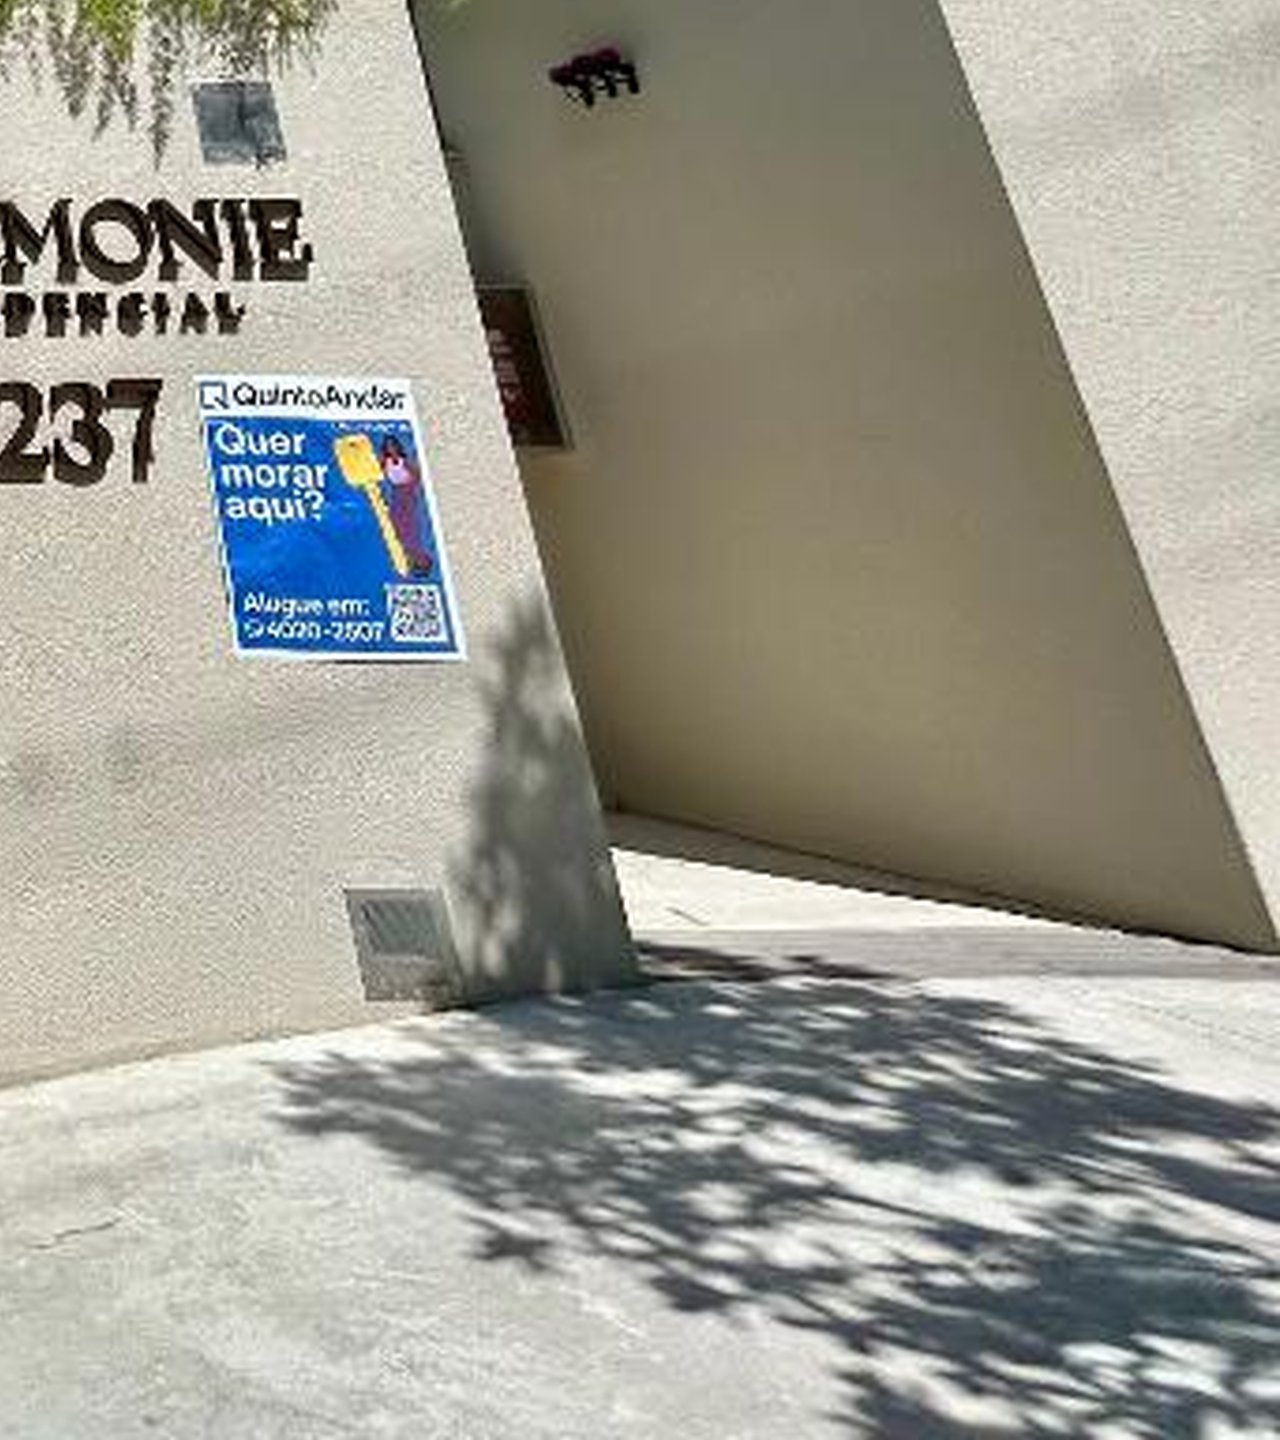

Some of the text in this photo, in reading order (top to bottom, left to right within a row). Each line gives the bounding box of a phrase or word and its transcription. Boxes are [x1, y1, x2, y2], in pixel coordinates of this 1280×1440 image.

[232, 382, 405, 410] QuintoAndar
[215, 423, 306, 455] Quer
[220, 463, 328, 489] morar
[225, 490, 326, 526] aqui?
[243, 591, 370, 620] Alugue em:
